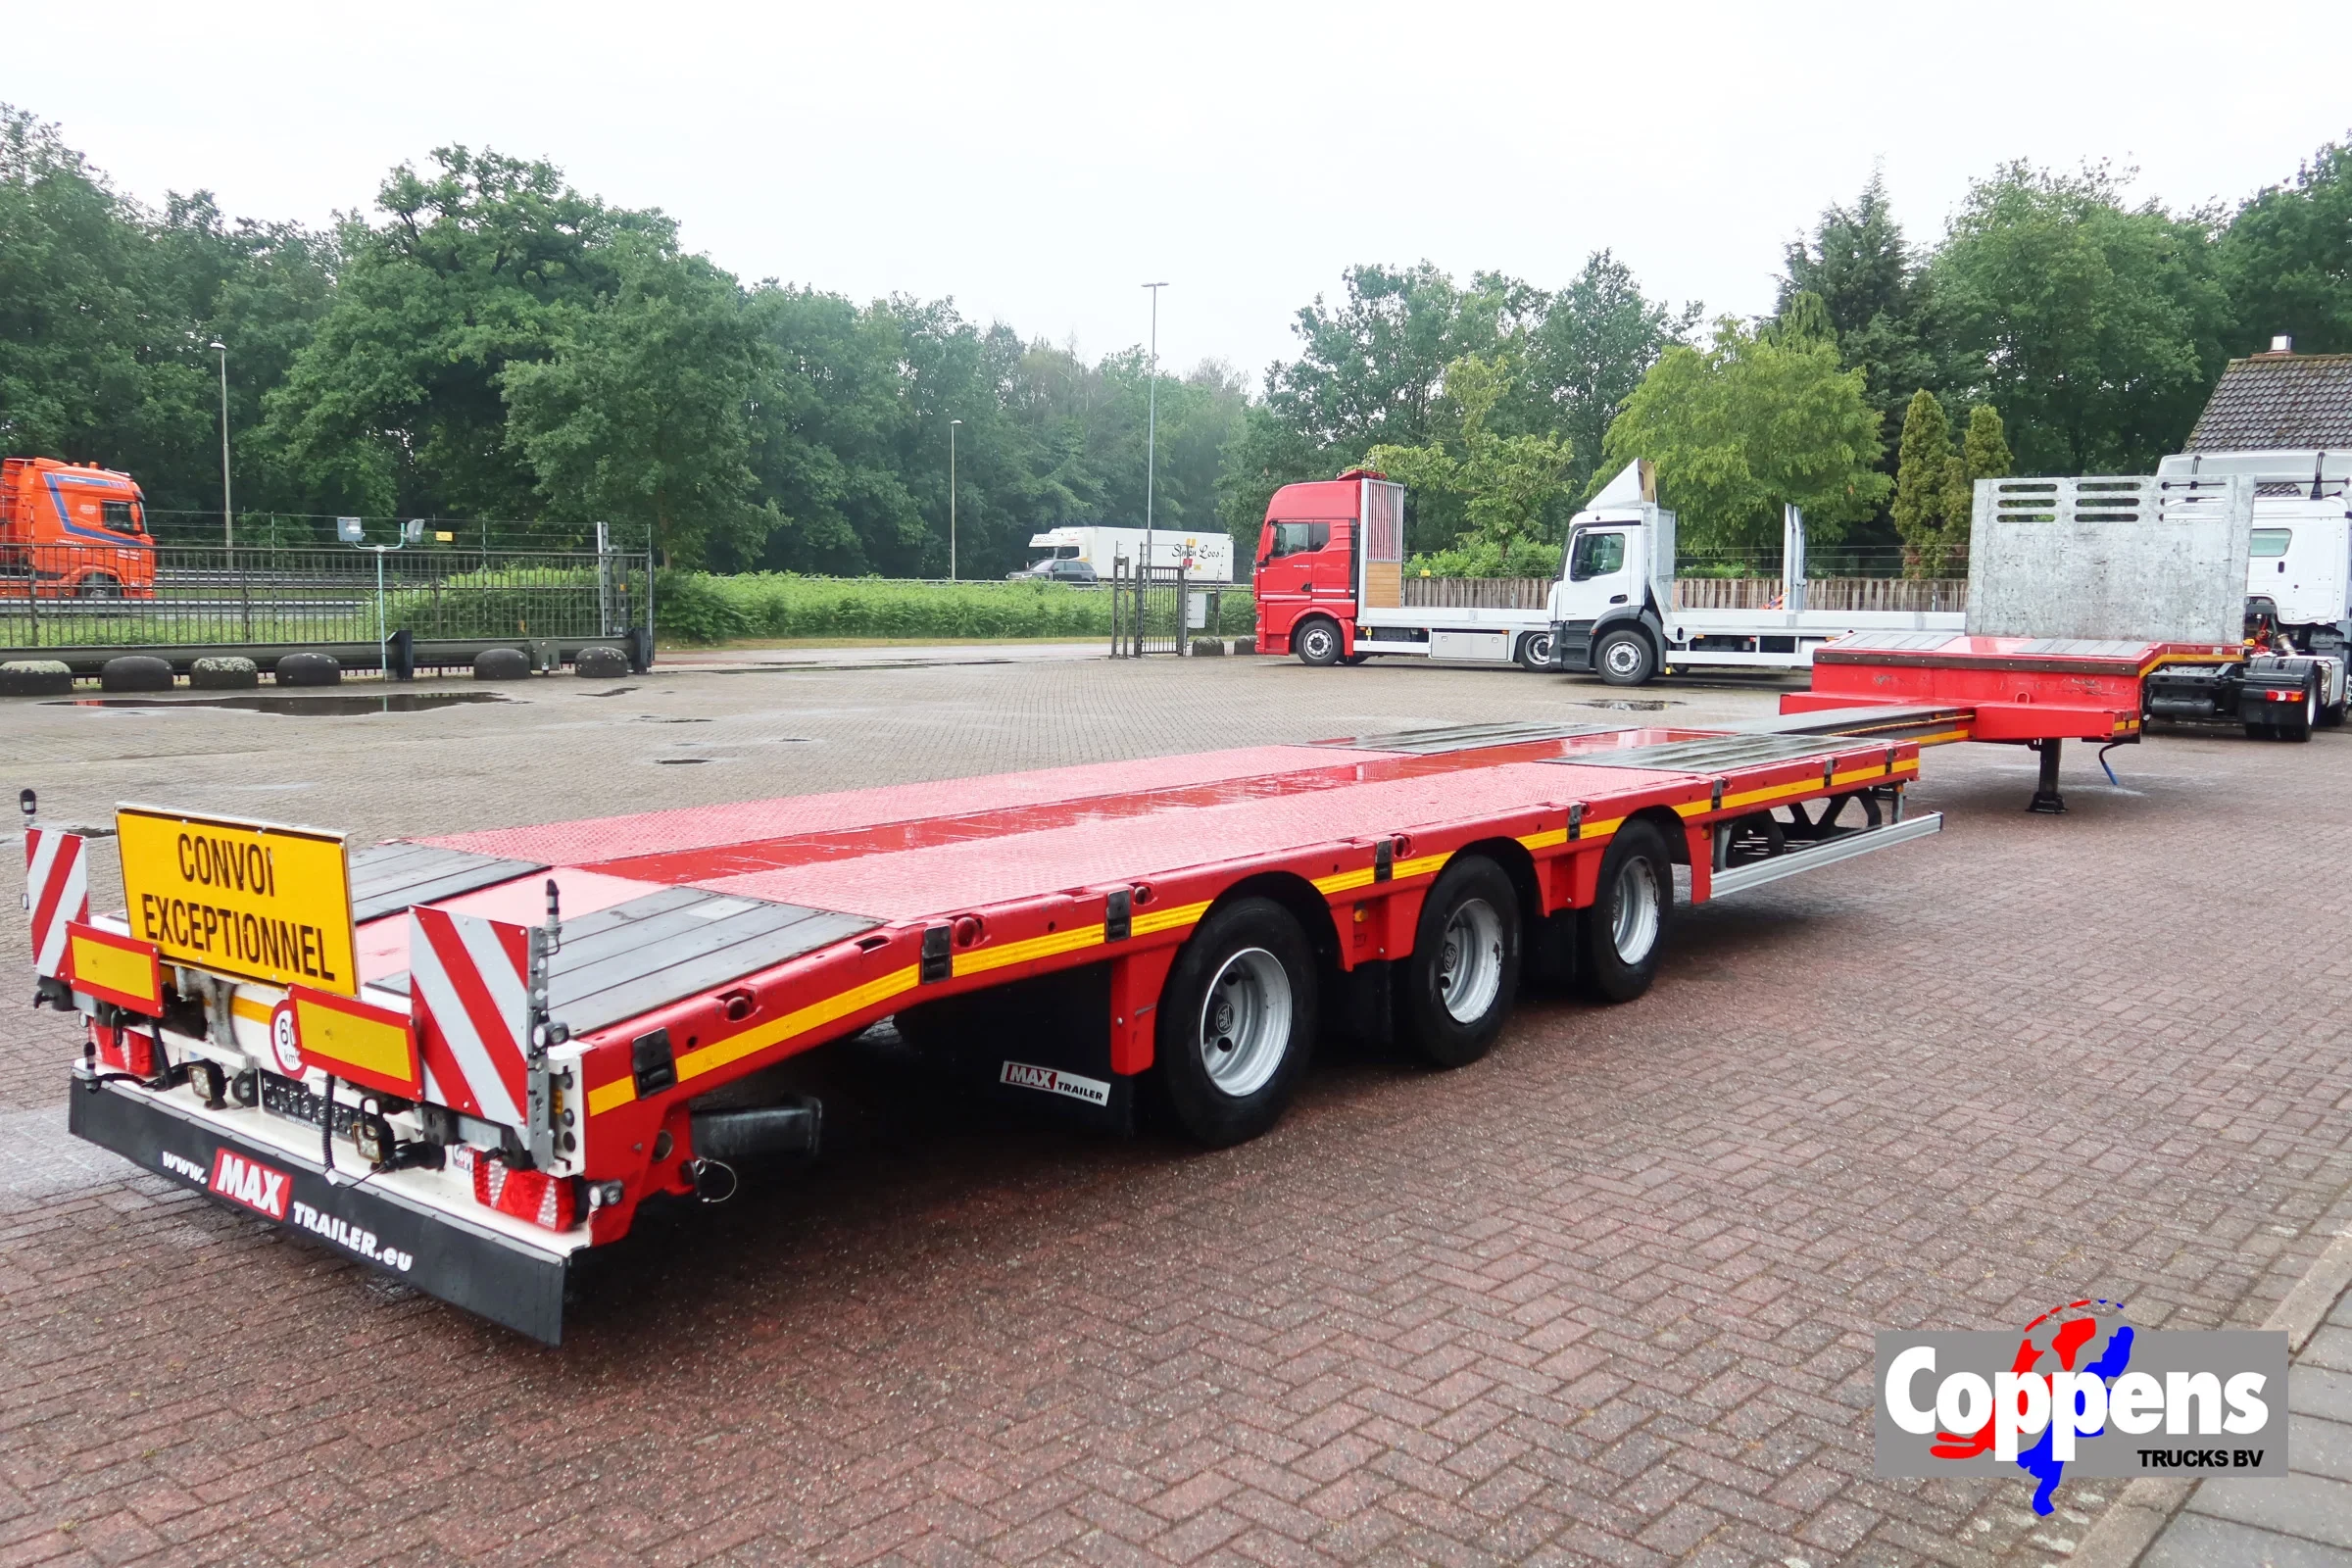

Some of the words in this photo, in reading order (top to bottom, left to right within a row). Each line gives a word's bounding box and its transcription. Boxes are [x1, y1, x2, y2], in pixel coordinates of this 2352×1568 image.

[1199, 544, 1220, 560] Loos
[177, 833, 275, 897] CONVOI
[141, 893, 335, 982] EXCEPTIONNEL
[1009, 1064, 1053, 1089] MAX
[1057, 1081, 1103, 1101] TRAILER
[162, 1151, 208, 1185] www.
[216, 1153, 284, 1216] MAX
[293, 1200, 414, 1272] TRAILER.eu
